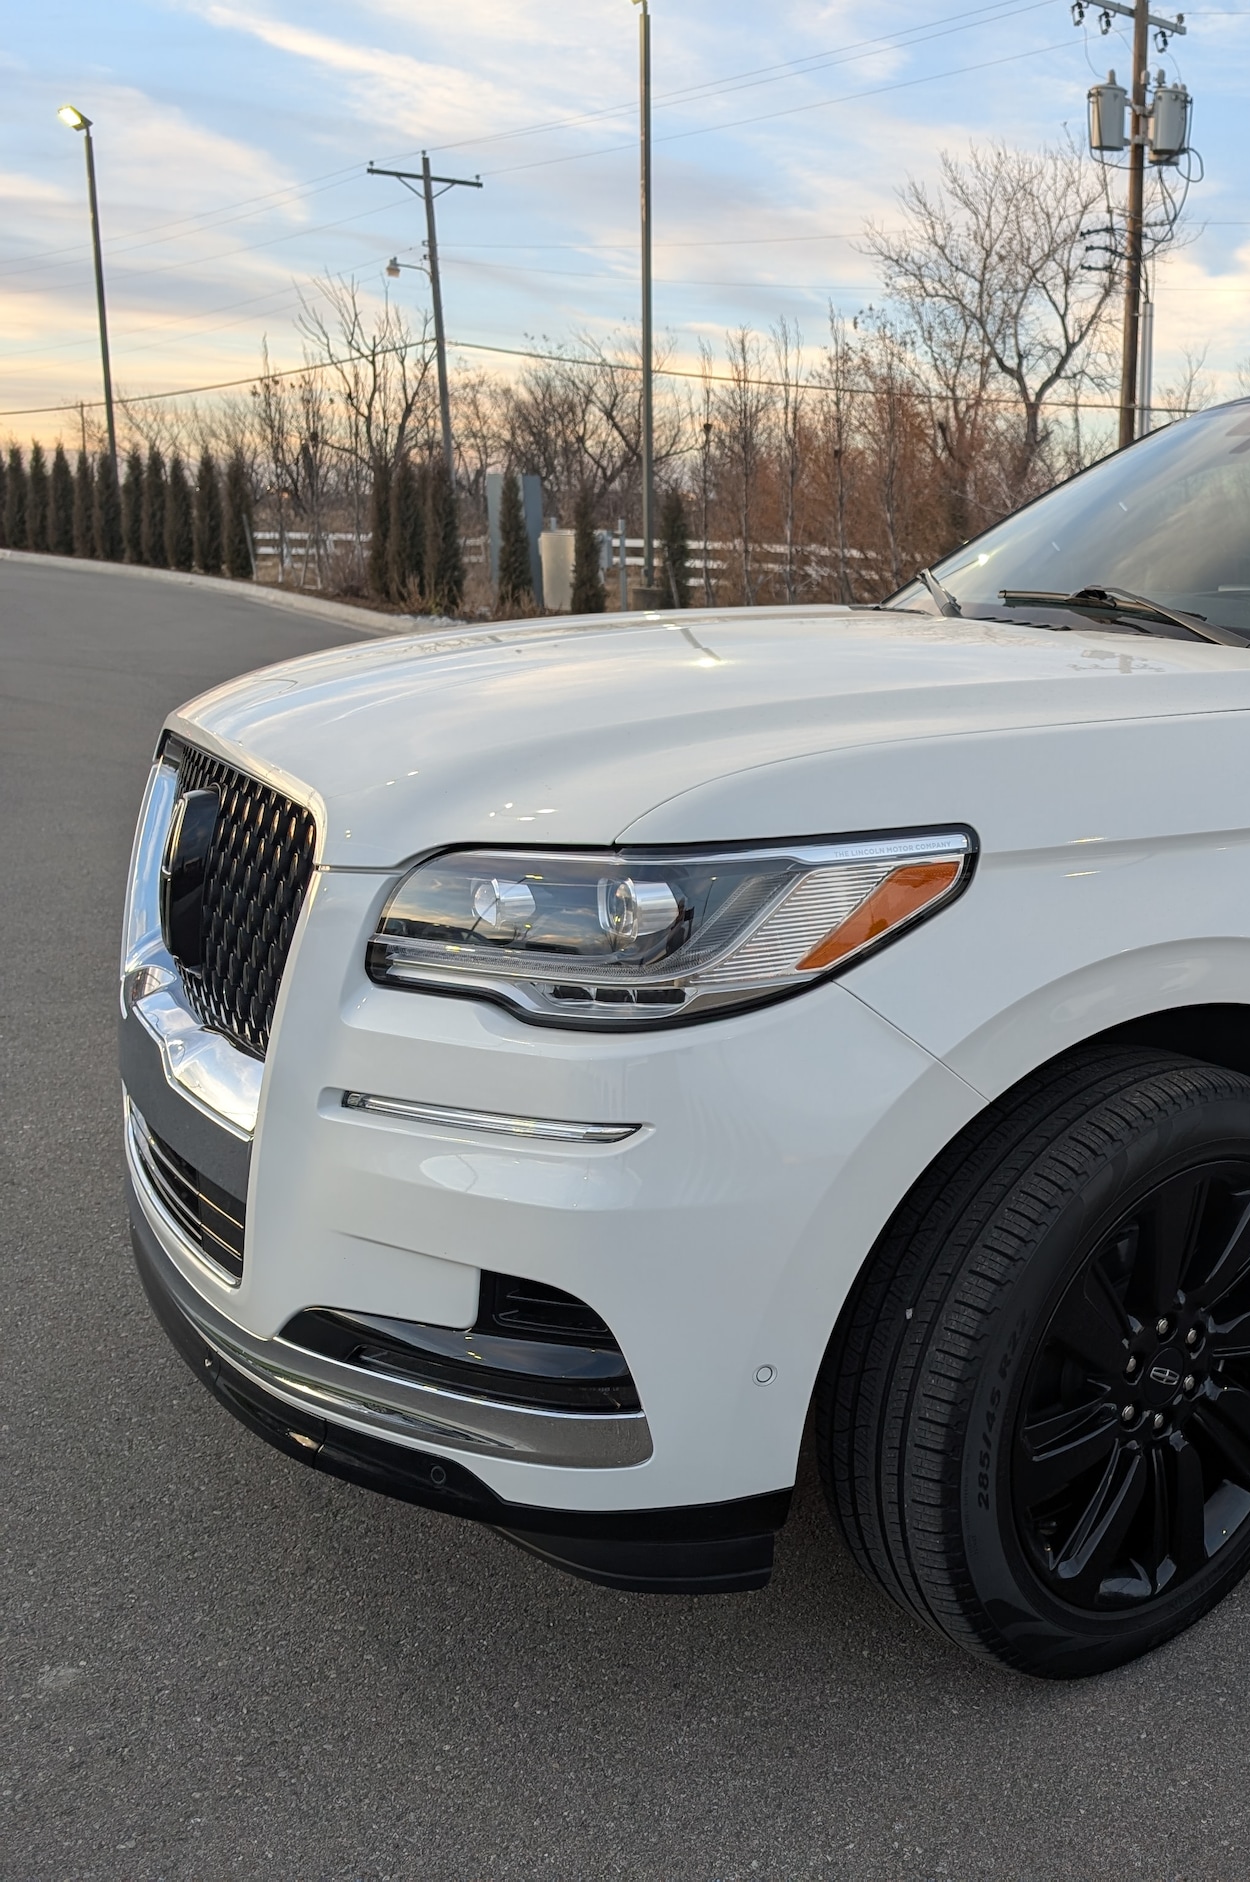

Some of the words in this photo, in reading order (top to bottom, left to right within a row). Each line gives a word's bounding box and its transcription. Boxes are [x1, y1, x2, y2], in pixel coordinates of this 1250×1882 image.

[851, 848, 885, 857] LINCOLN
[886, 845, 914, 854] MOTOR
[915, 841, 951, 851] COMPANY
[977, 1386, 1002, 1511] 285/45
